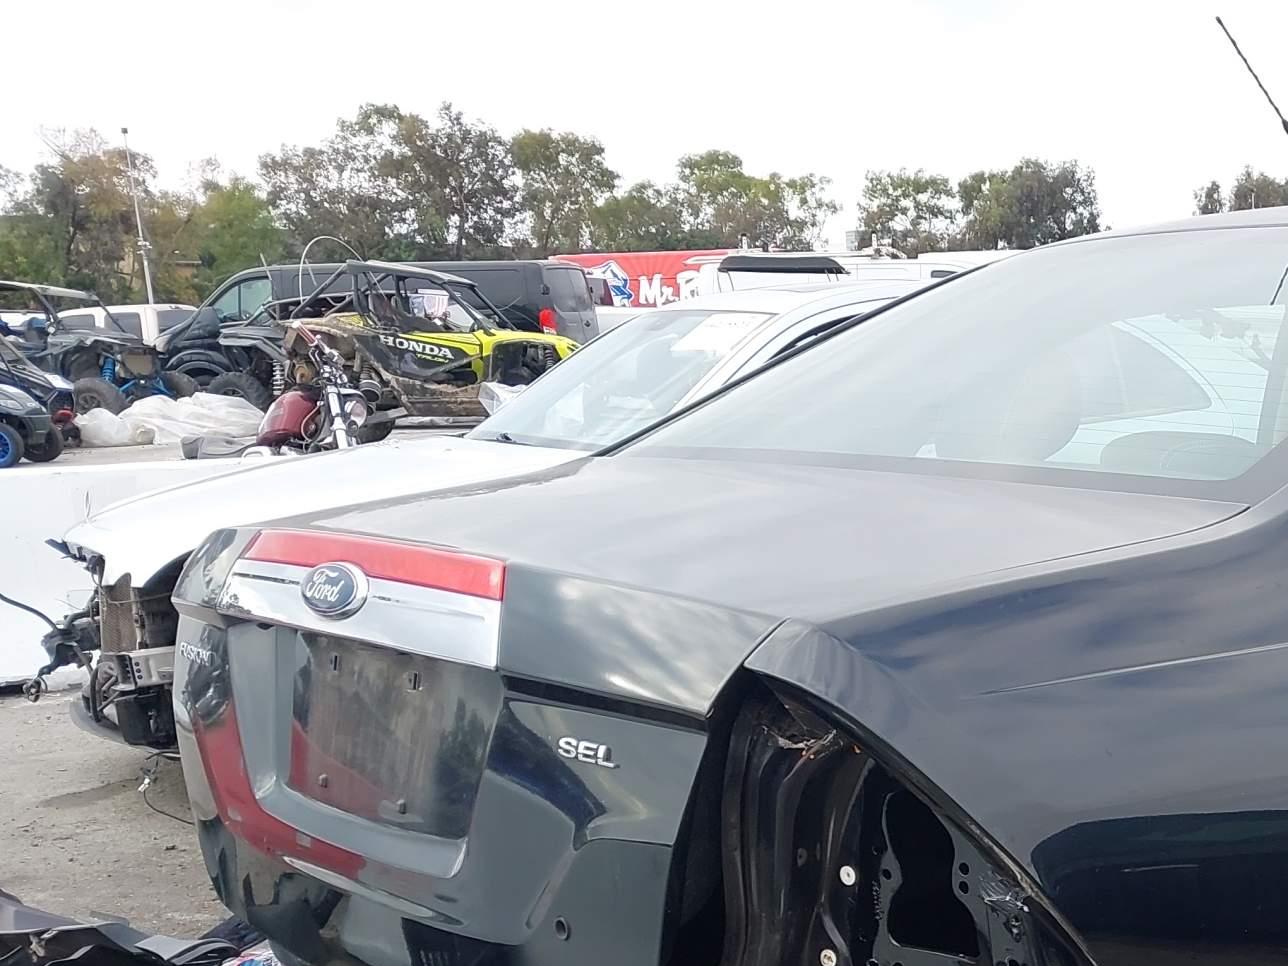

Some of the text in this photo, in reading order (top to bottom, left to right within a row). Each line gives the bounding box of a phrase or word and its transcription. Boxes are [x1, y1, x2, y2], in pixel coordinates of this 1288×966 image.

[378, 334, 455, 360] HONDA
[306, 568, 345, 602] Ford
[557, 736, 615, 768] SEL
